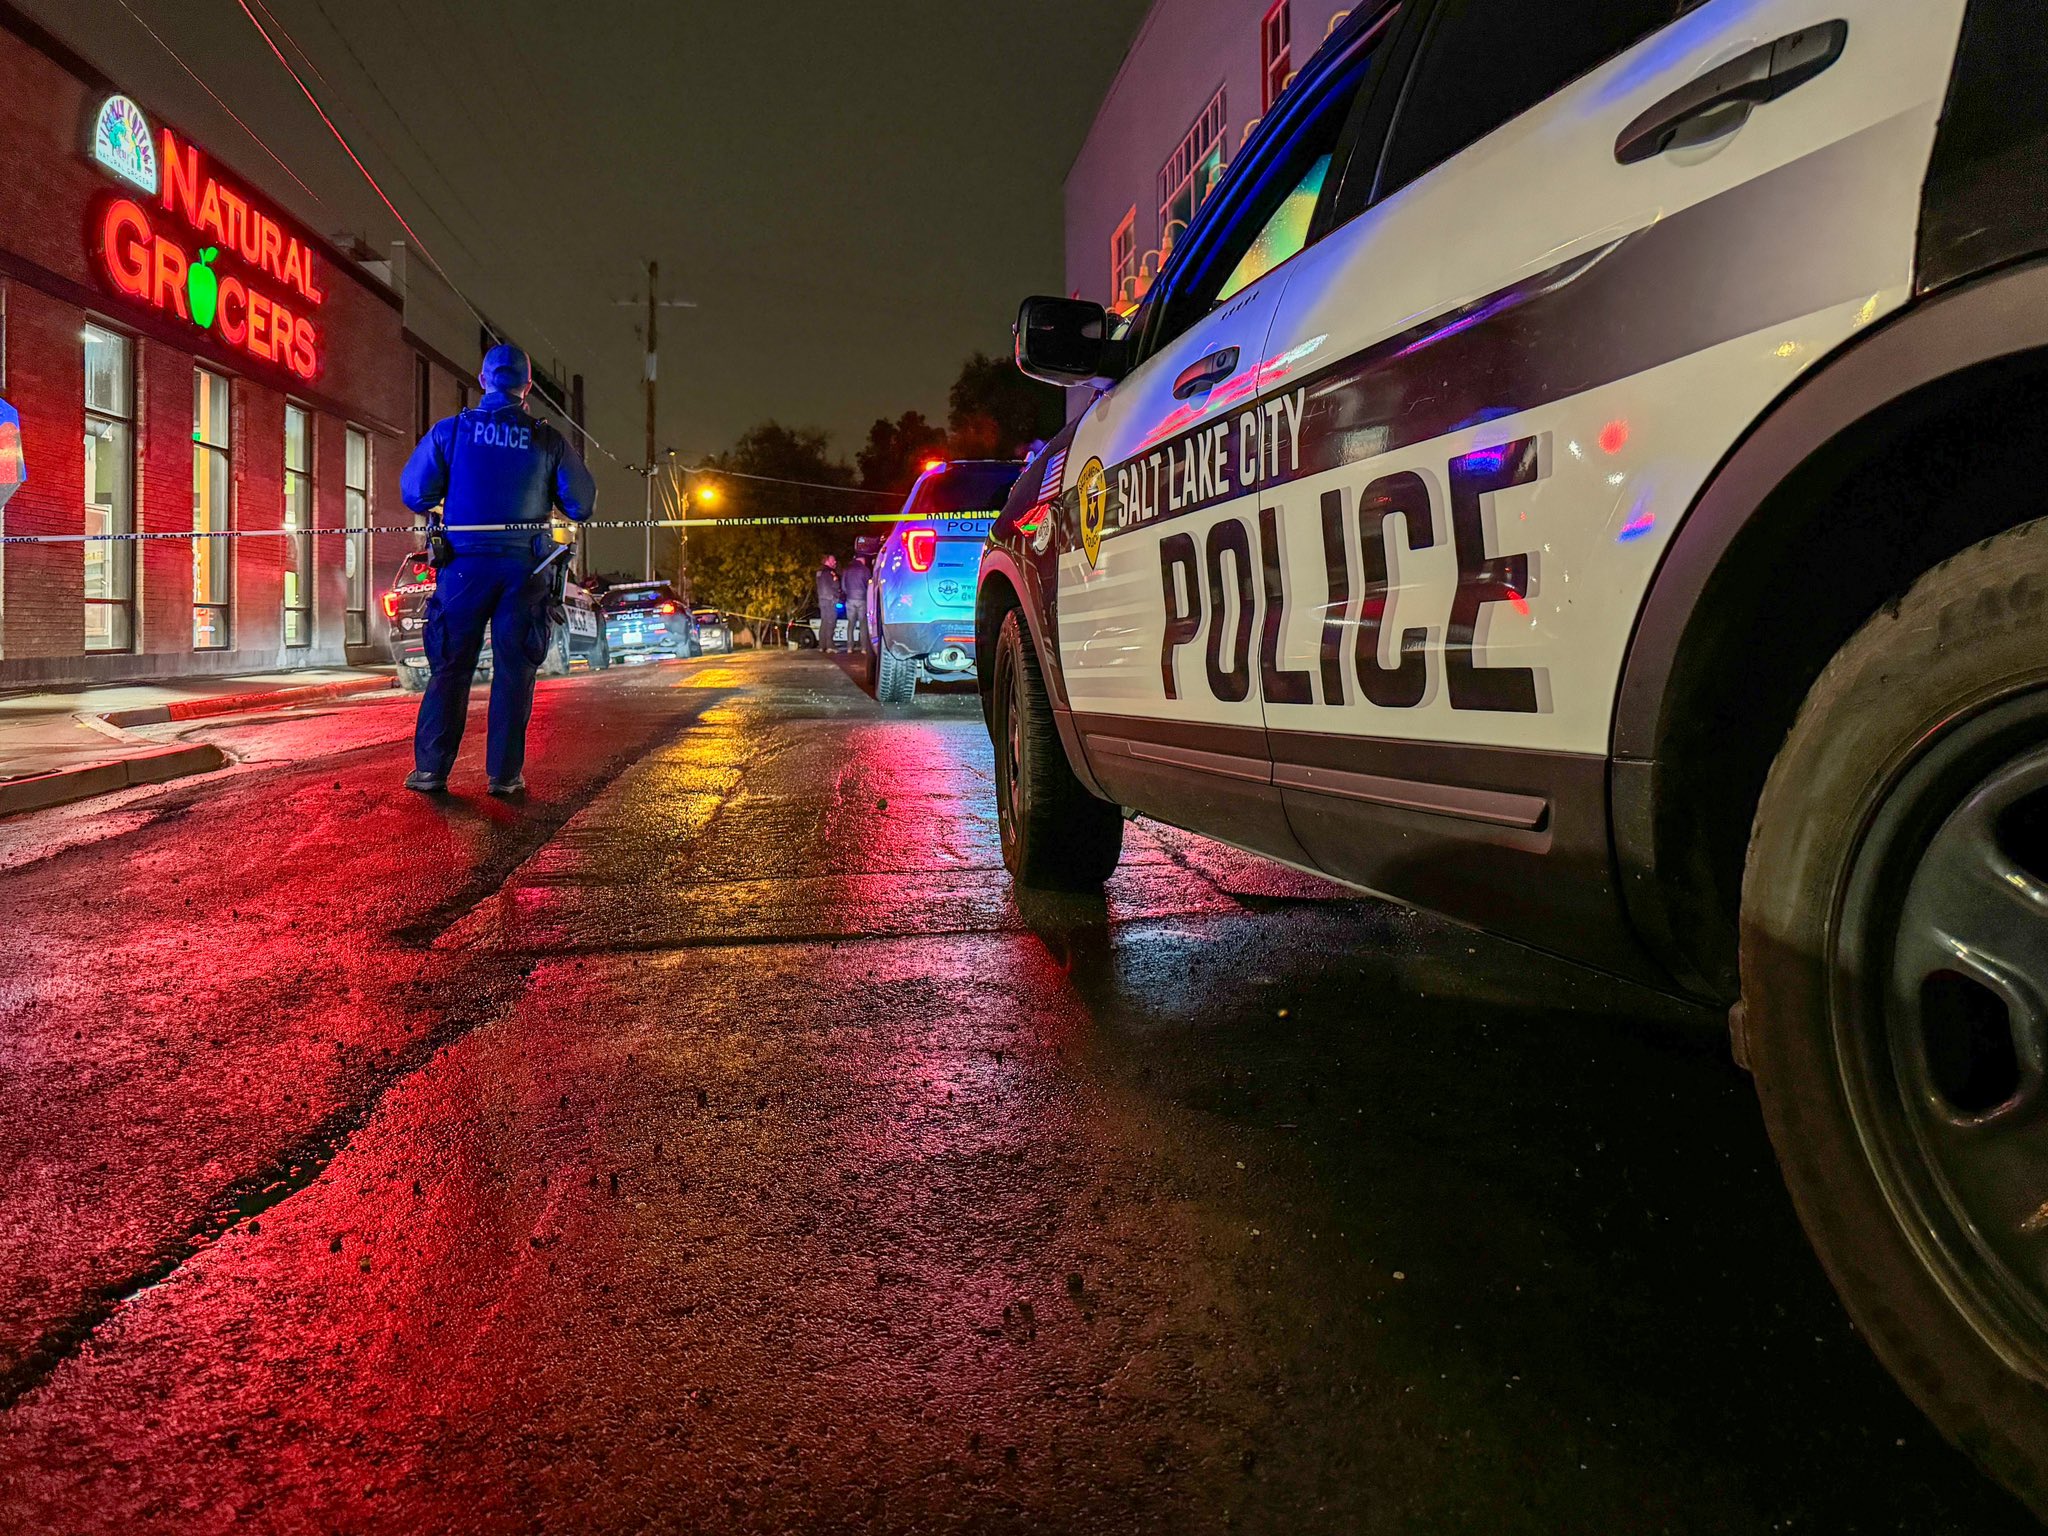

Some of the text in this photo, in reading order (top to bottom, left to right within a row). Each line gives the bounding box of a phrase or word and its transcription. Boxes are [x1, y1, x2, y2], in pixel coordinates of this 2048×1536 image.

[164, 128, 321, 304] NATURAL
[474, 421, 529, 449] POLICE
[1117, 388, 1305, 528] SALT LAKE CITY
[947, 522, 990, 532] POLI
[1160, 432, 1546, 714] POLICE
[401, 583, 437, 594] POLICE
[616, 613, 644, 621] POLICE
